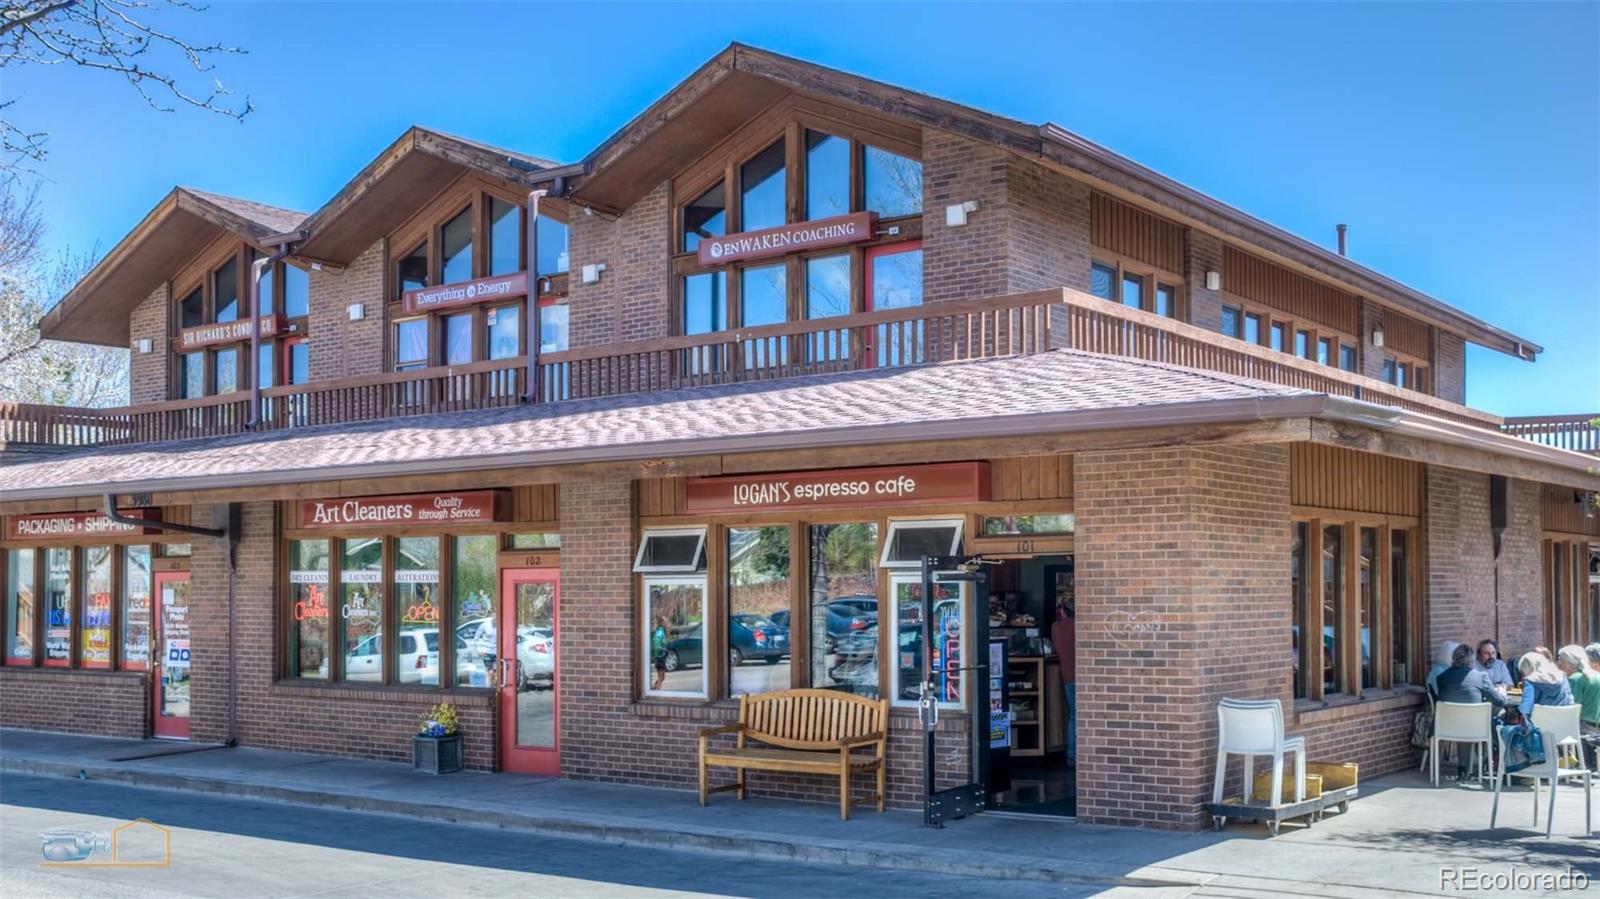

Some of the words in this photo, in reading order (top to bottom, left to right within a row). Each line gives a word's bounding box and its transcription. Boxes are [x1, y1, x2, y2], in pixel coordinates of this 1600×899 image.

[792, 222, 855, 244] COACHING
[417, 288, 465, 304] Everything
[477, 280, 511, 296] Energy
[183, 331, 194, 346] SIR
[196, 325, 232, 343] RICHARD'S
[733, 481, 791, 505] LOGAN'S
[794, 478, 870, 500] espresso
[875, 475, 915, 497] cafe
[313, 502, 341, 524] Art
[342, 500, 413, 522] Cleaners
[433, 496, 464, 509] Quality
[418, 508, 449, 521] through
[450, 507, 481, 519] Service
[18, 517, 75, 535] PACKAGING
[525, 555, 543, 566] 102
[408, 605, 440, 621] OPEN
